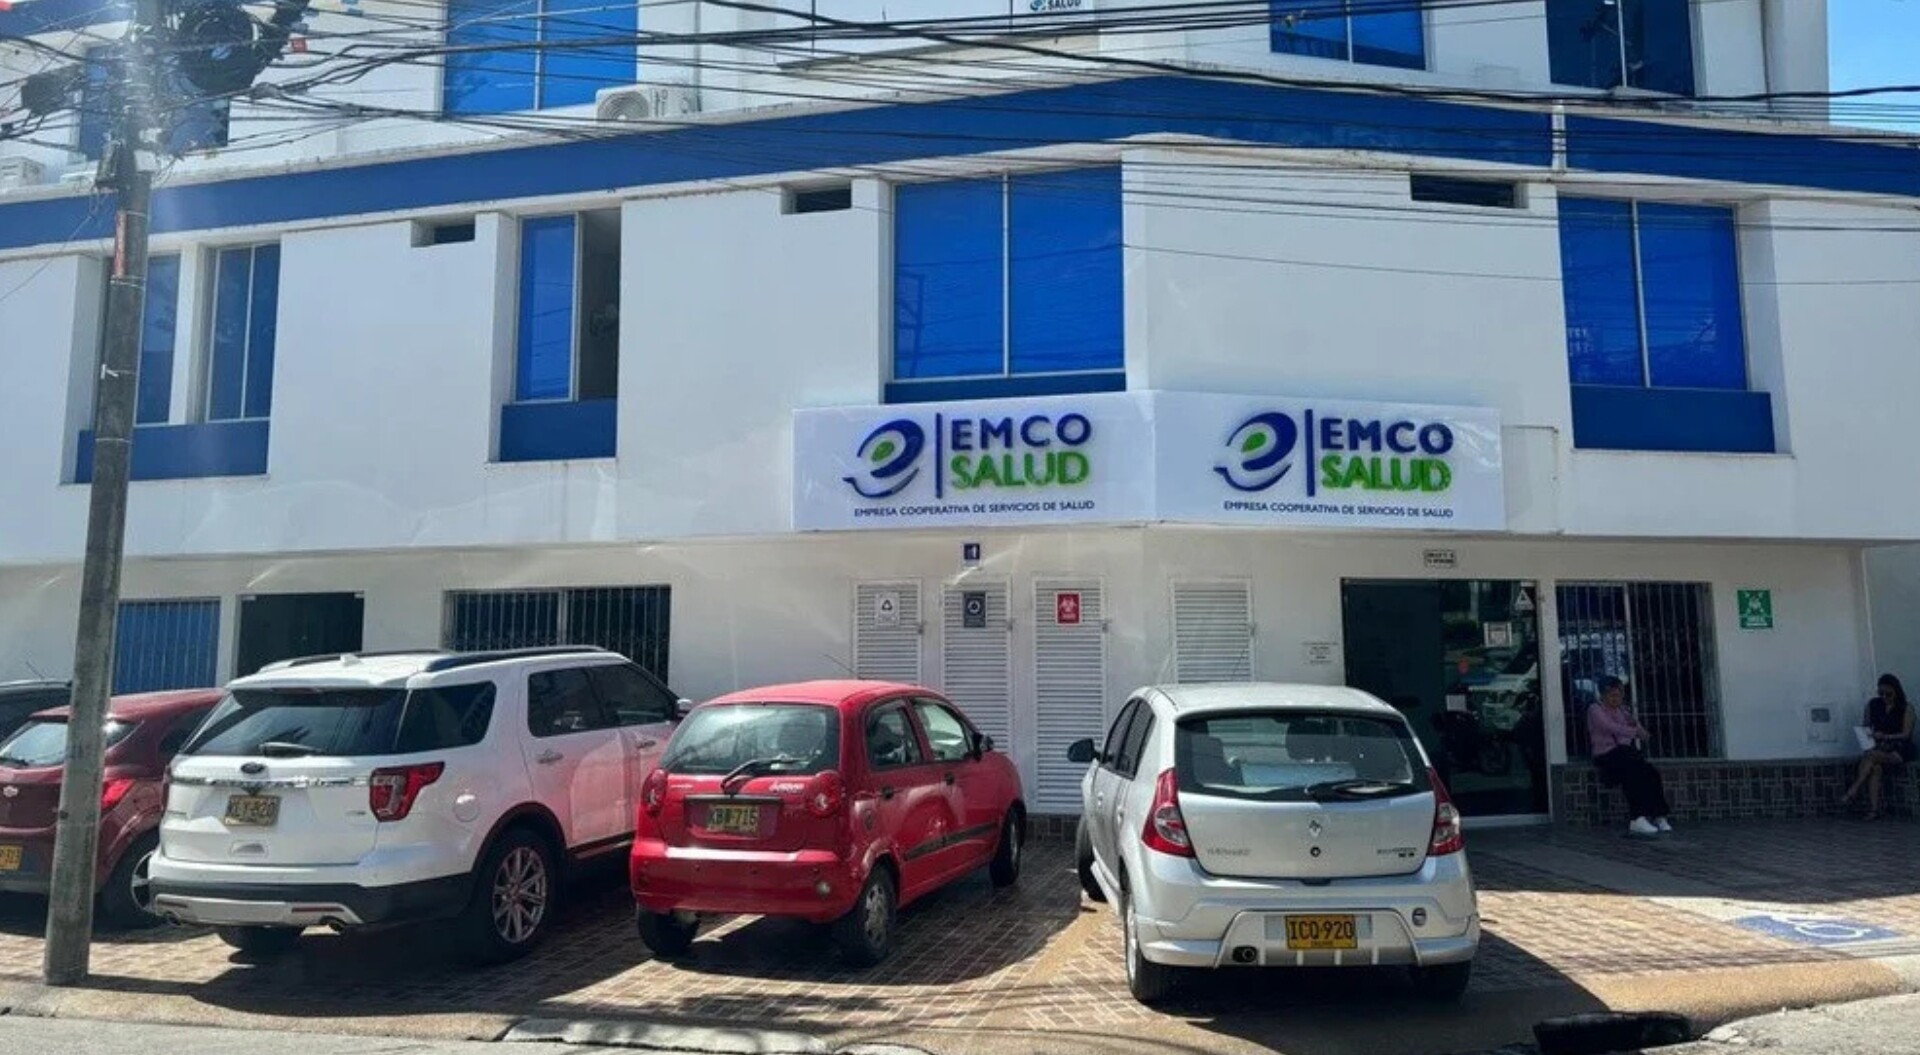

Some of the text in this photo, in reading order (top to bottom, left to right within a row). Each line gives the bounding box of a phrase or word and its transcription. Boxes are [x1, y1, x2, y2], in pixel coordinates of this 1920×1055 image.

[952, 413, 1092, 451] EMCO
[1320, 417, 1454, 455] EMCO
[951, 451, 1090, 490] SALUD
[1321, 454, 1453, 492] SALUD
[854, 500, 1095, 517] EMPRESA COOPERATIVA DE SERVICIOS DE SALUD
[1224, 500, 1454, 518] EMPRESA COOPERATIVA DE SERVICIOS DE SALUD
